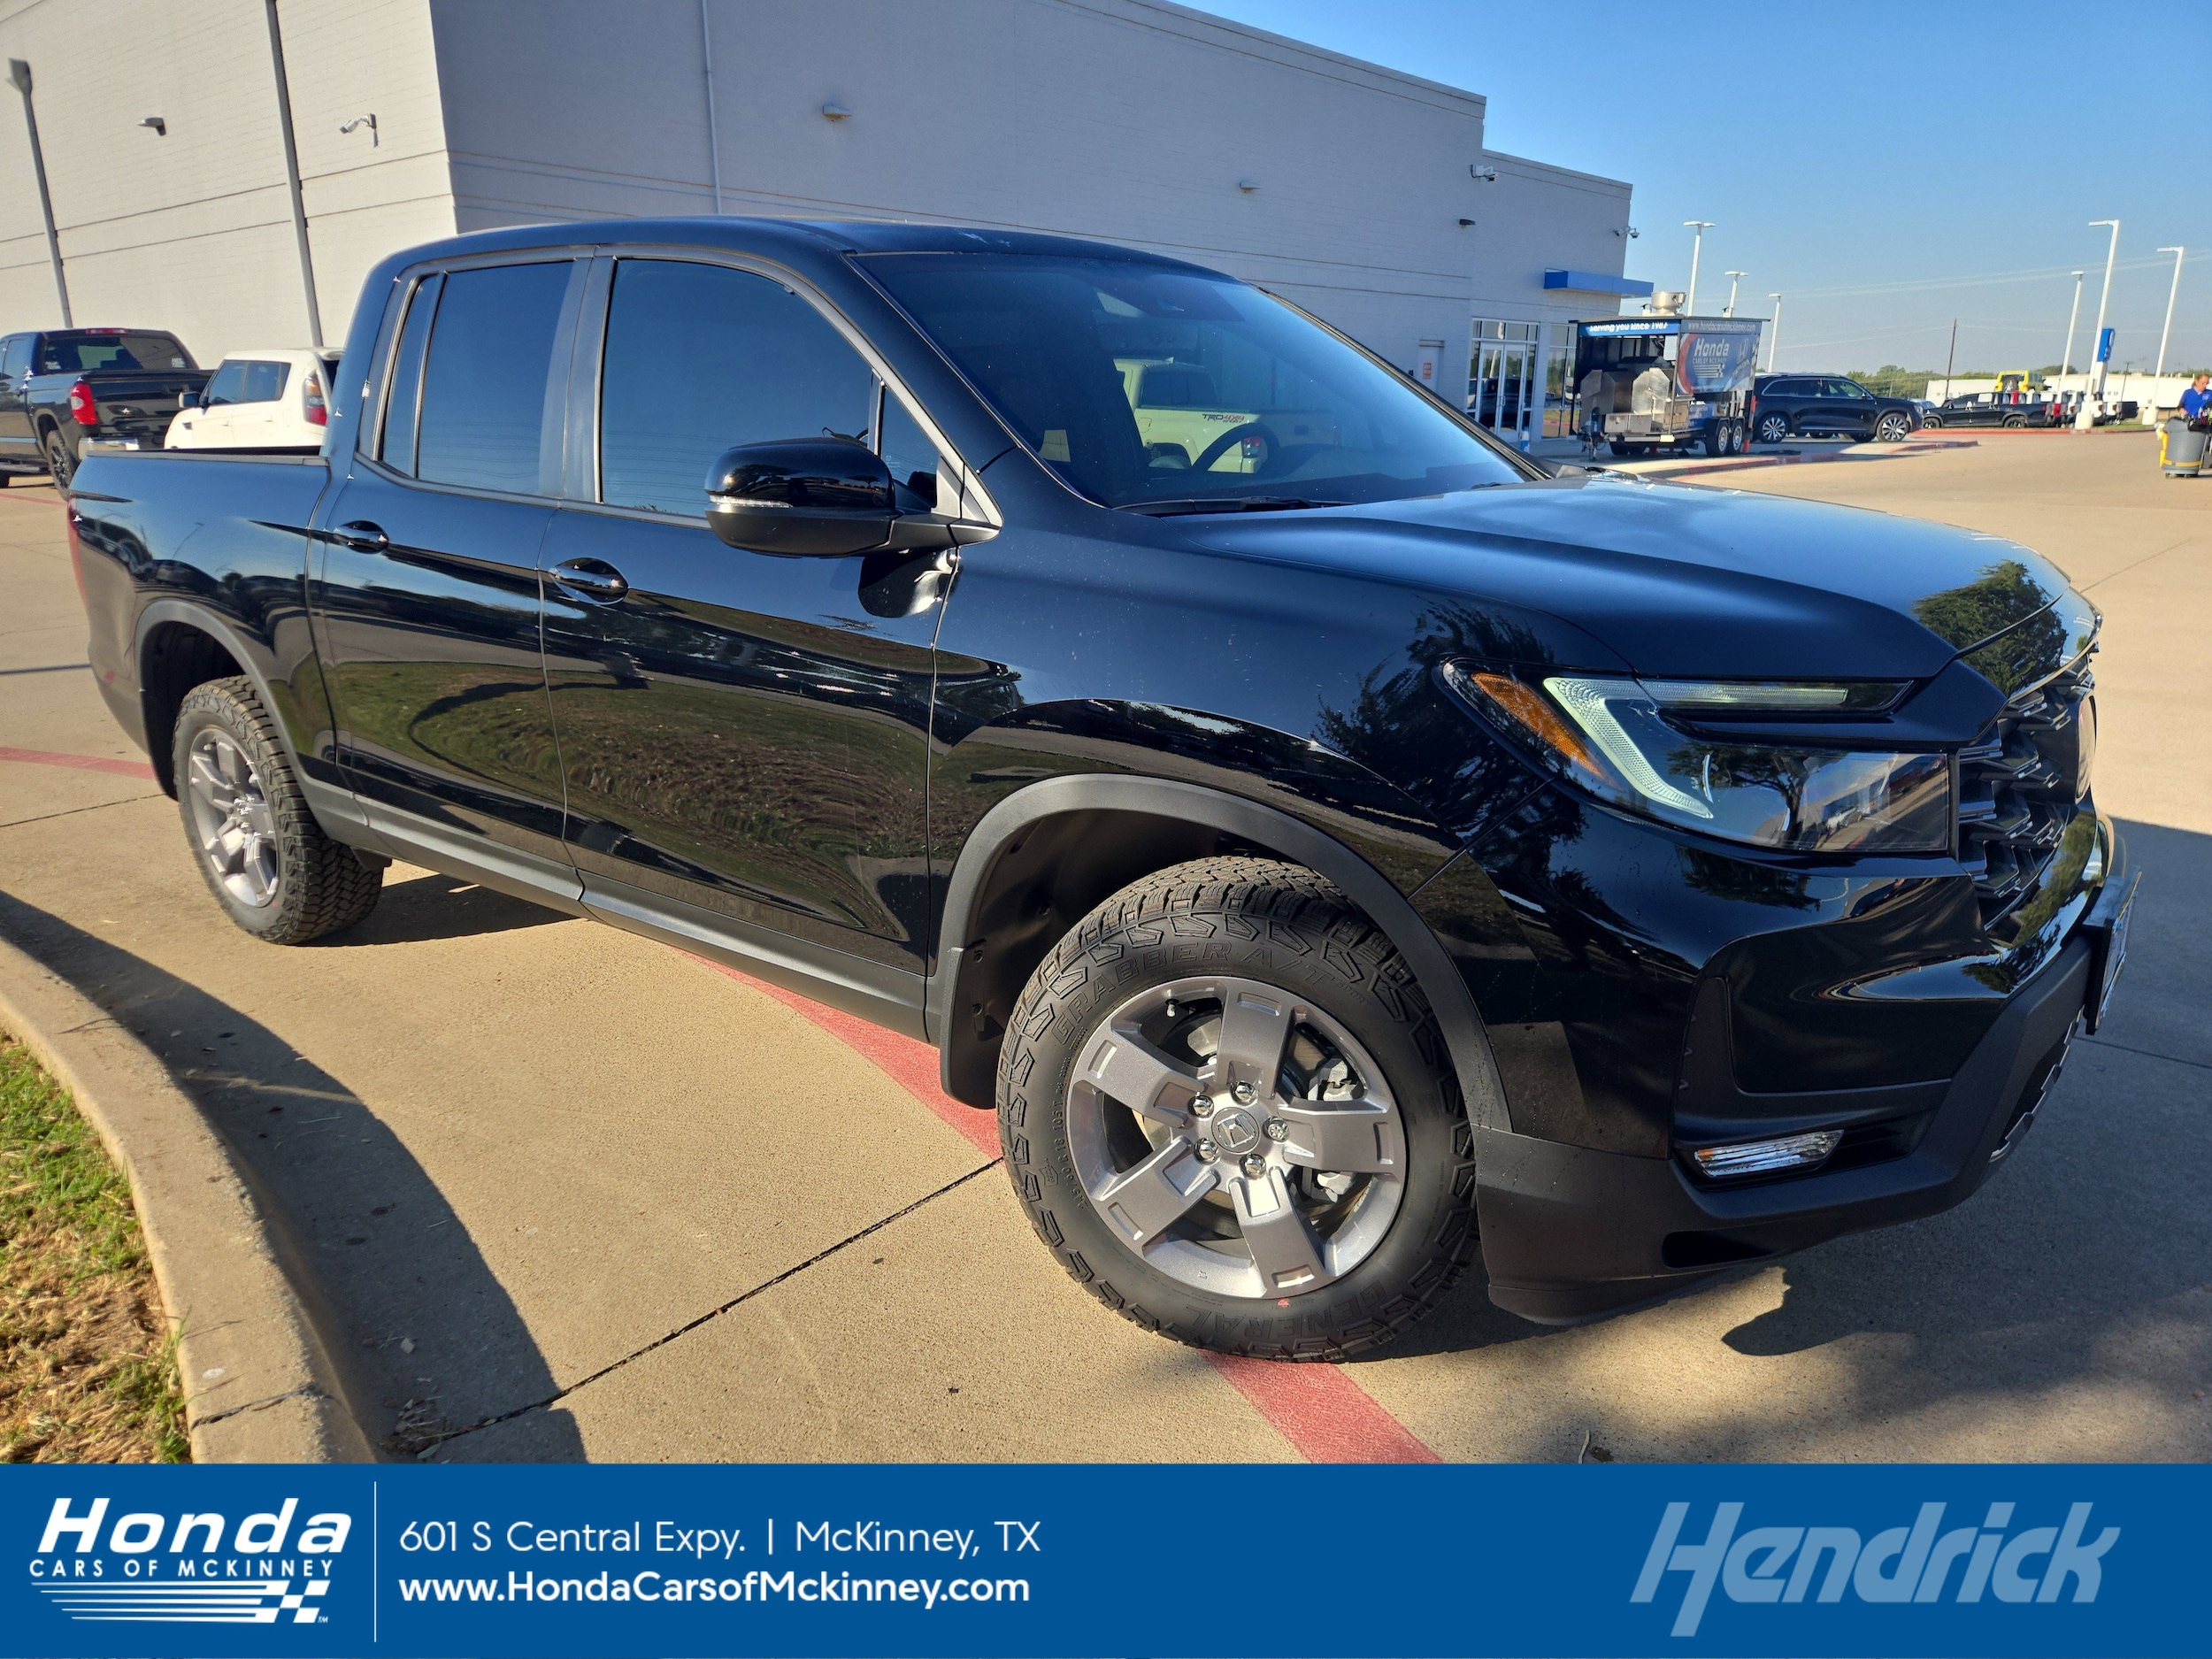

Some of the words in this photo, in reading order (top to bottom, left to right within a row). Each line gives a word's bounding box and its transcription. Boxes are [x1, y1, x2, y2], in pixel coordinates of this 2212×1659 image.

[1694, 337, 1730, 357] Honda
[1050, 942, 1232, 1046] GRABBER
[1240, 947, 1332, 988] A/T
[1186, 1280, 1389, 1340] GENERAL
